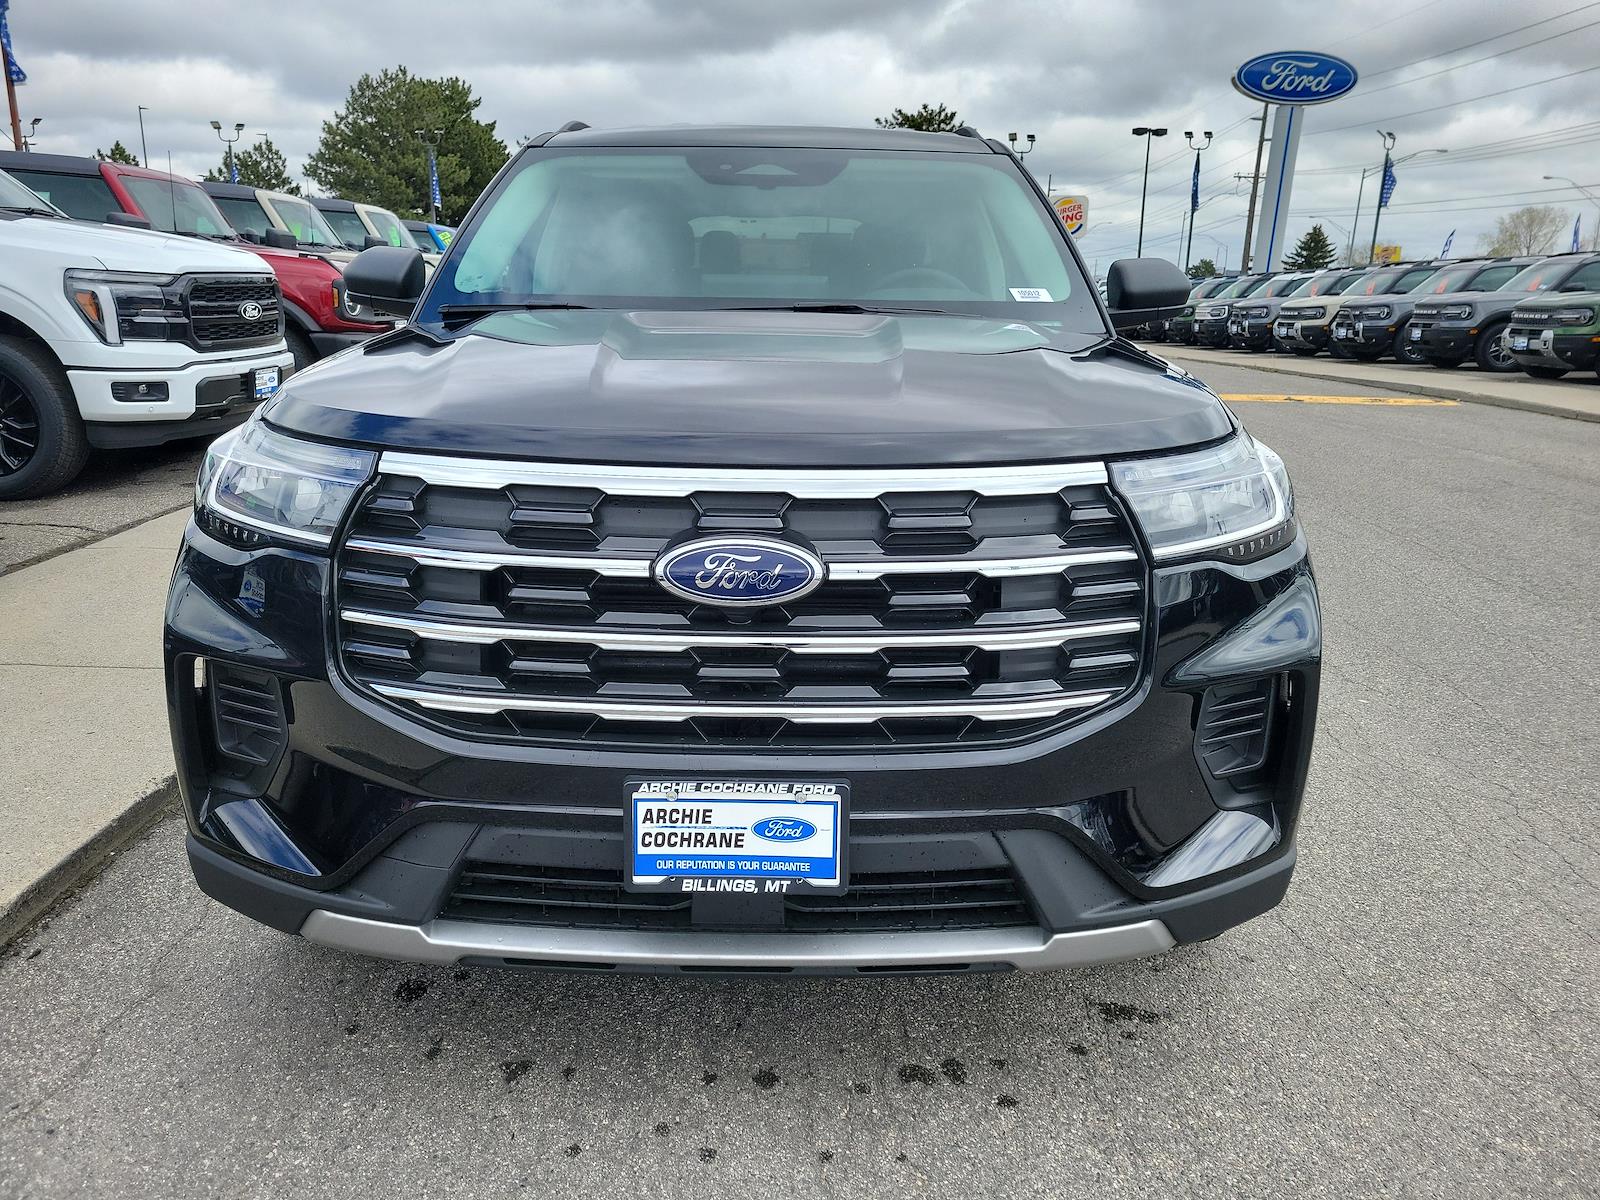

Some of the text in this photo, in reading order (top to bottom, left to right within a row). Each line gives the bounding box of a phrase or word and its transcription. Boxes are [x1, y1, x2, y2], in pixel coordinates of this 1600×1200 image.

[1261, 60, 1336, 92] Ford
[1056, 204, 1082, 213] URGER
[1061, 211, 1083, 223] ING
[695, 552, 784, 590] Ford
[638, 783, 836, 795] ARCHIE COCHRANE FORD
[642, 808, 713, 824] ARCHIE
[764, 819, 802, 838] Ford
[641, 832, 745, 848] COCHRANE
[656, 860, 811, 872] OUR REPUTATION IS YOUR GUARANTEE
[681, 879, 791, 894] BILLINGS, MT
